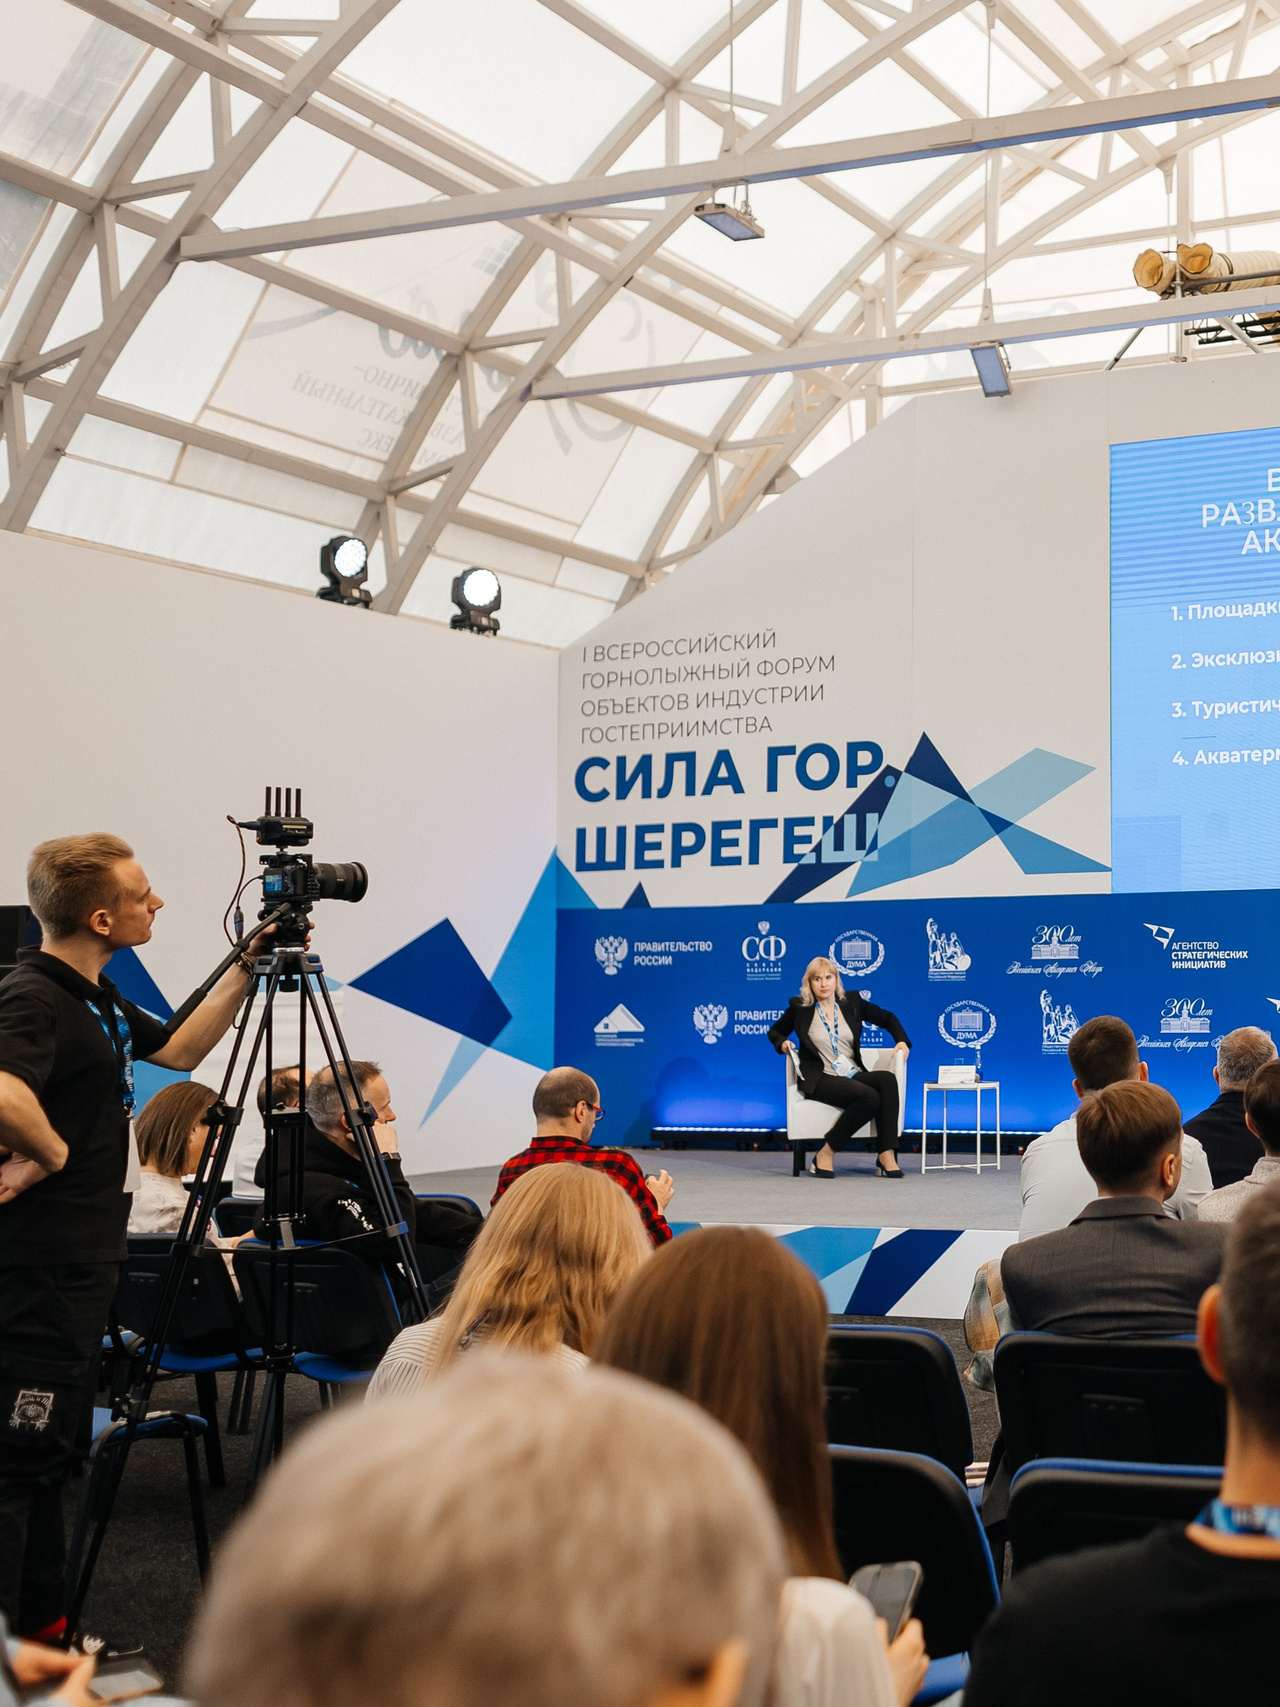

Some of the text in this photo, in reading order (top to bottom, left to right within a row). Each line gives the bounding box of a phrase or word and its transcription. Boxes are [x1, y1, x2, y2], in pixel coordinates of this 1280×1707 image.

[1171, 606, 1183, 621] 1.
[593, 628, 776, 662] ВСЕРОССИЙСКИЙ
[1171, 654, 1187, 669] 2.
[582, 655, 835, 689] ГОРНОЛЫЖНЫЙ ФОРУМ
[581, 684, 824, 717] ОБЪЕКТОВ ИНДУСТРИИ
[1171, 701, 1187, 717] 3.
[581, 716, 773, 744] ГОСТЕПРИИМСТВА
[1172, 750, 1189, 766] 4.
[574, 749, 745, 802] СИЛА
[575, 812, 879, 872] ШЕРЕГЕШ
[634, 940, 713, 953] ПРАВИТЕЛЬСТВО
[741, 935, 787, 962] СФ
[1172, 941, 1219, 950] АГЕНТСТВО
[634, 955, 673, 966] РОССИИ
[1172, 950, 1249, 960] СТРАТЕГИЧЕСКИХ
[846, 960, 867, 969] ДУМА
[1172, 960, 1227, 970] ИНИЦИАТИВ
[734, 1010, 784, 1021] ПРАВИТЕЛ
[956, 1032, 978, 1040] ДУМА
